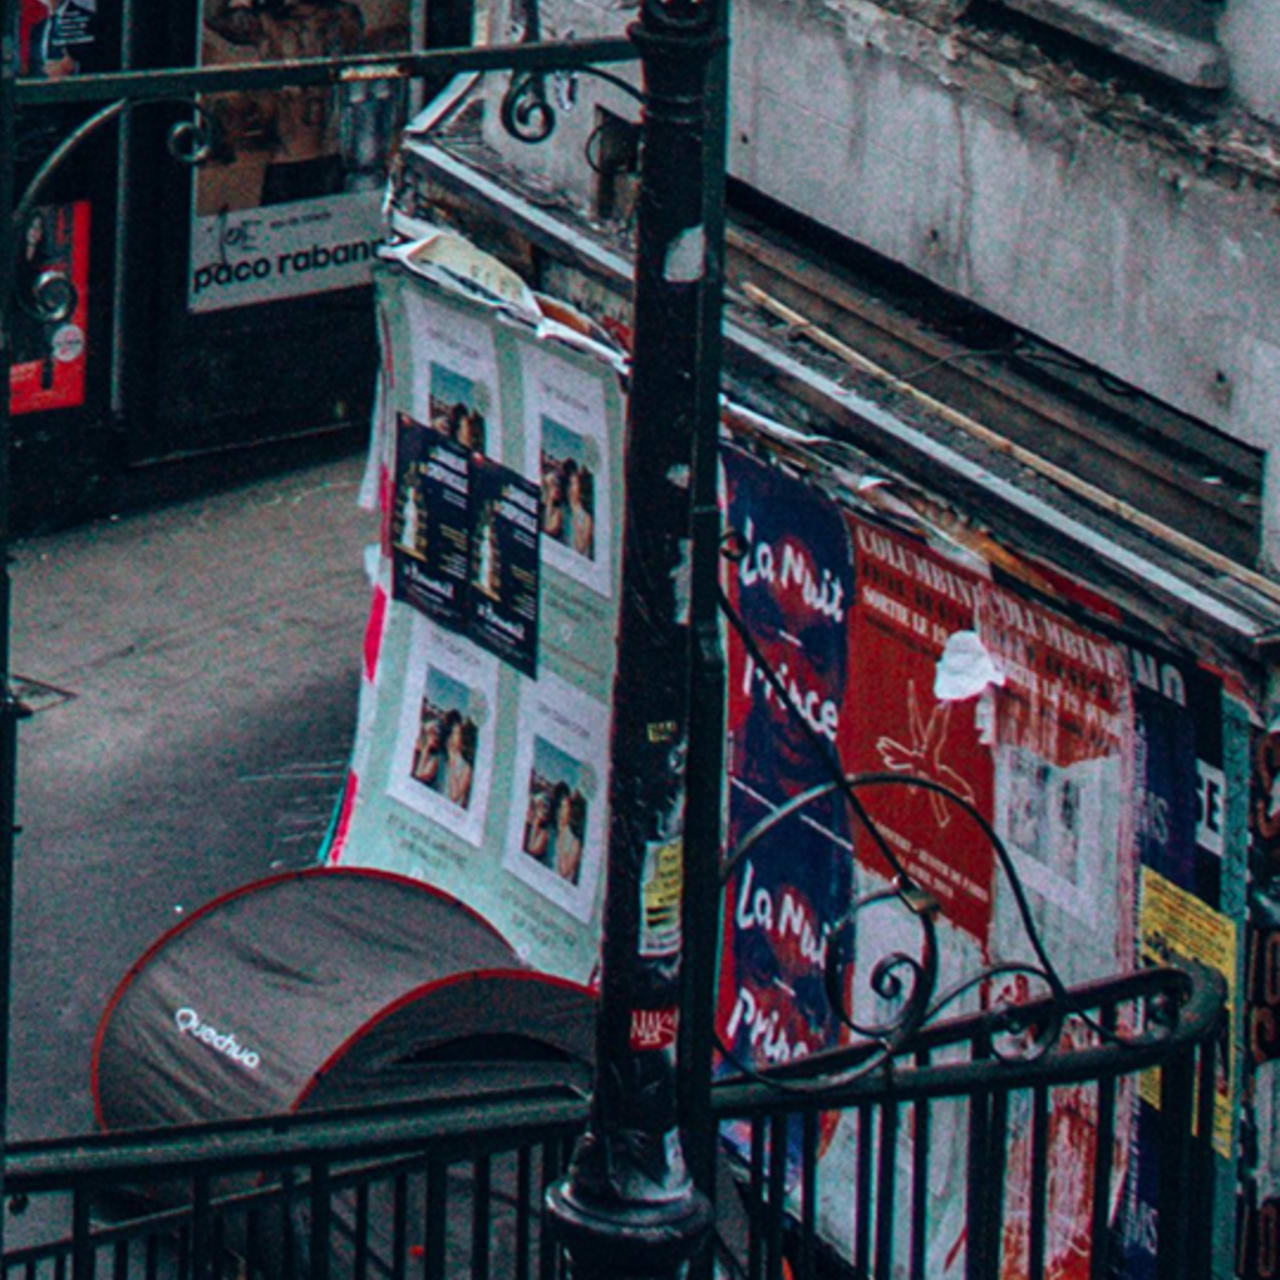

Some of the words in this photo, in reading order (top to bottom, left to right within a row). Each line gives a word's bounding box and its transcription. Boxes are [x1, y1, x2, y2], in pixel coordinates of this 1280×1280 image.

[193, 257, 271, 294] paco
[740, 516, 775, 586] La
[780, 543, 844, 622] Nuit
[737, 859, 774, 930] La
